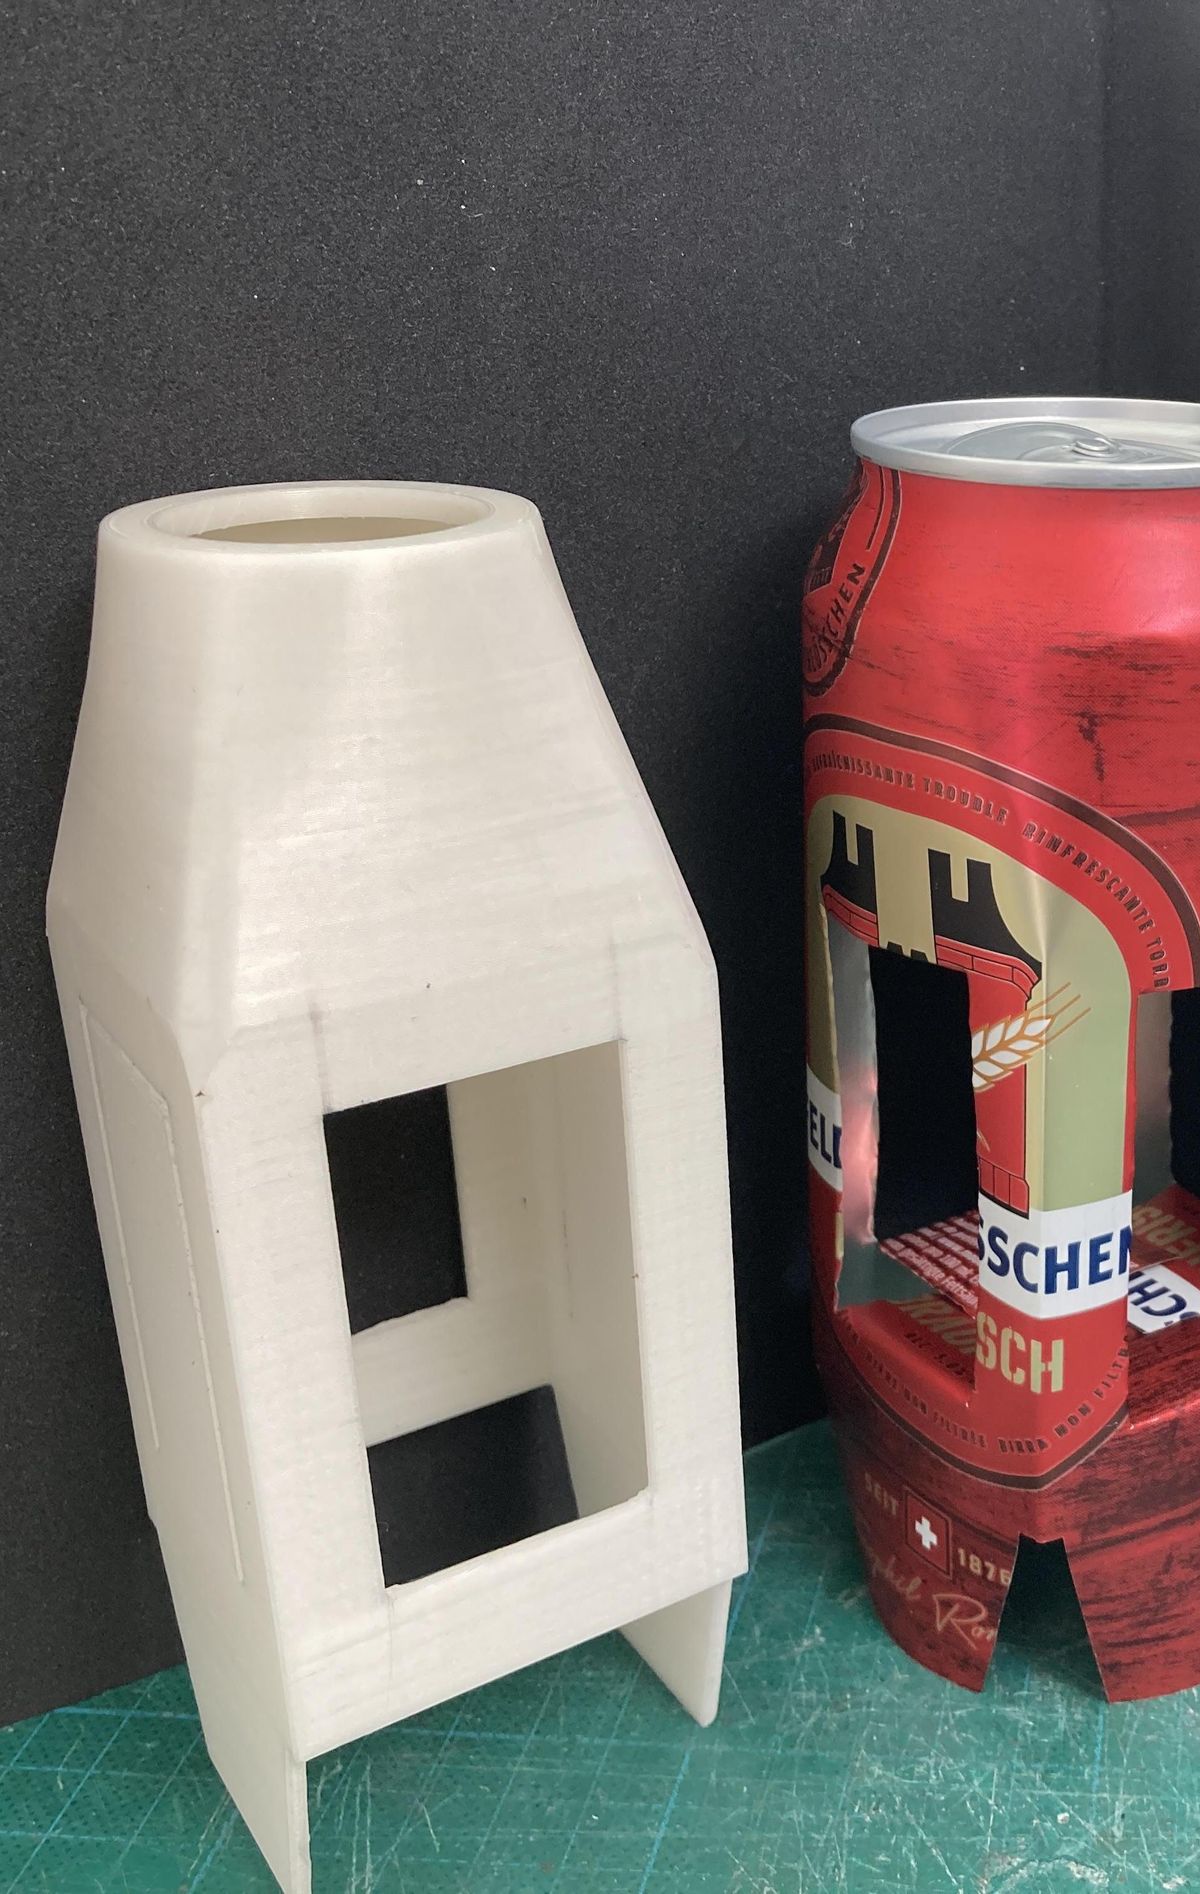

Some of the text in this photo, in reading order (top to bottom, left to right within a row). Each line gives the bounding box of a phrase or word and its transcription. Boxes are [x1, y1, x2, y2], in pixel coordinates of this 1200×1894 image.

[922, 777, 1008, 825] TROUBLE
[1021, 820, 1155, 935] RINFRESCANTE
[1054, 1400, 1094, 1438] NON
